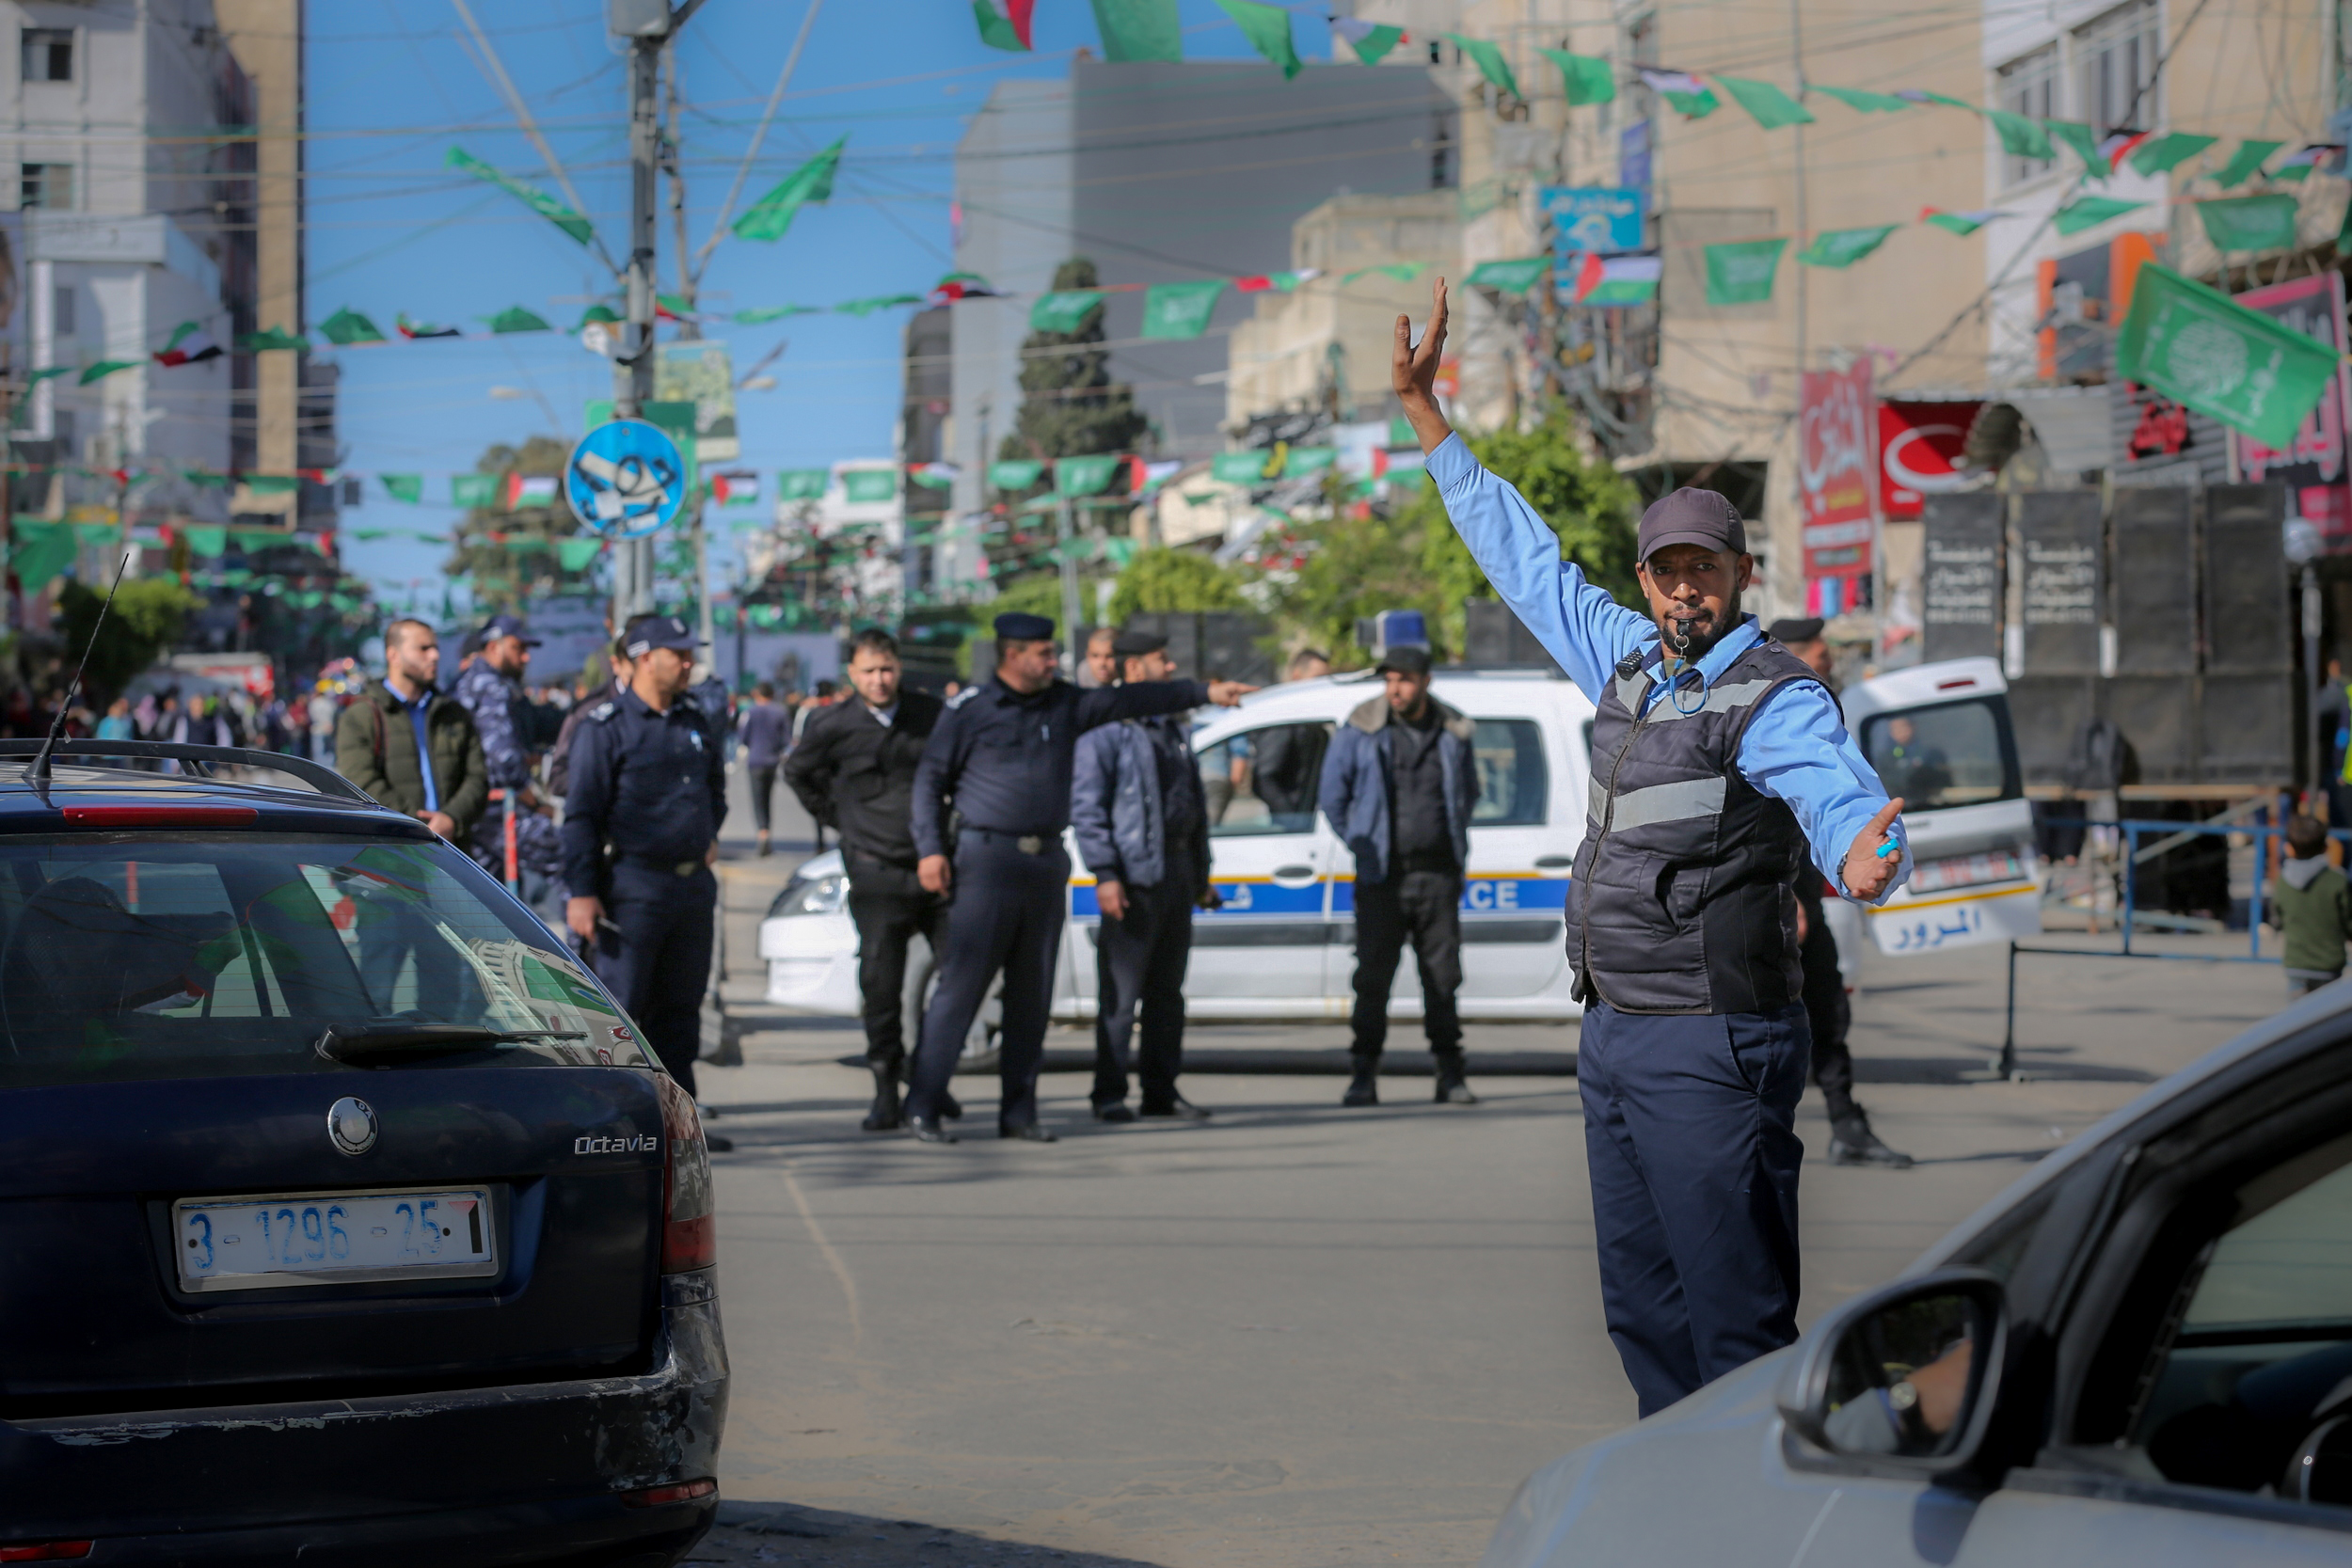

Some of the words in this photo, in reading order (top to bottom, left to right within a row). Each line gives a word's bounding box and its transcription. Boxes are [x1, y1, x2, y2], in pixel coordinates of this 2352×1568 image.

[1458, 880, 1518, 909] CE
[1893, 906, 1981, 950] المرور
[574, 1133, 658, 1155] Octavia
